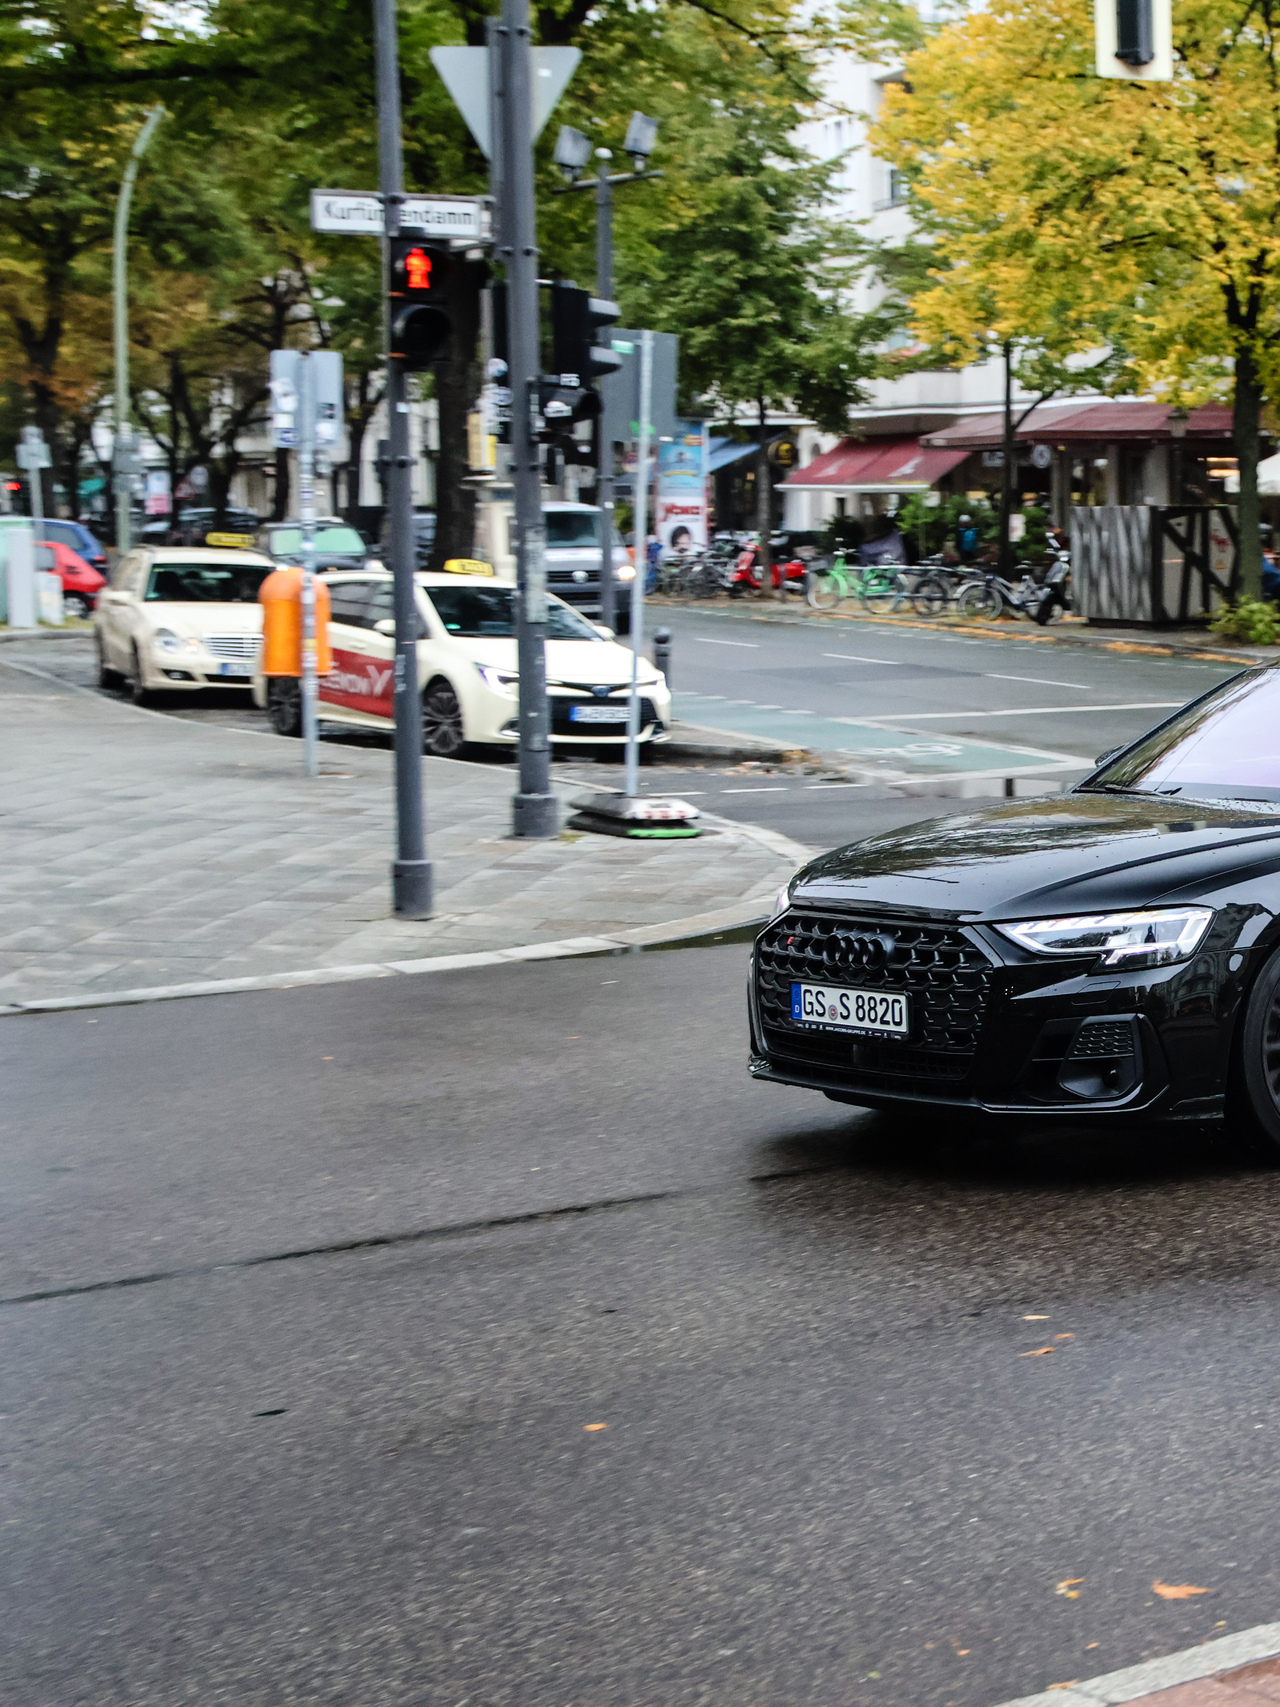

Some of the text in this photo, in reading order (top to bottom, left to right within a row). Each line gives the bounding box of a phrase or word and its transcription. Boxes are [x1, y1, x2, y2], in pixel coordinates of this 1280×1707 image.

[324, 200, 475, 225] Kurfürendamm
[794, 1004, 800, 1013] D
[803, 988, 903, 1027] GS S 8820
